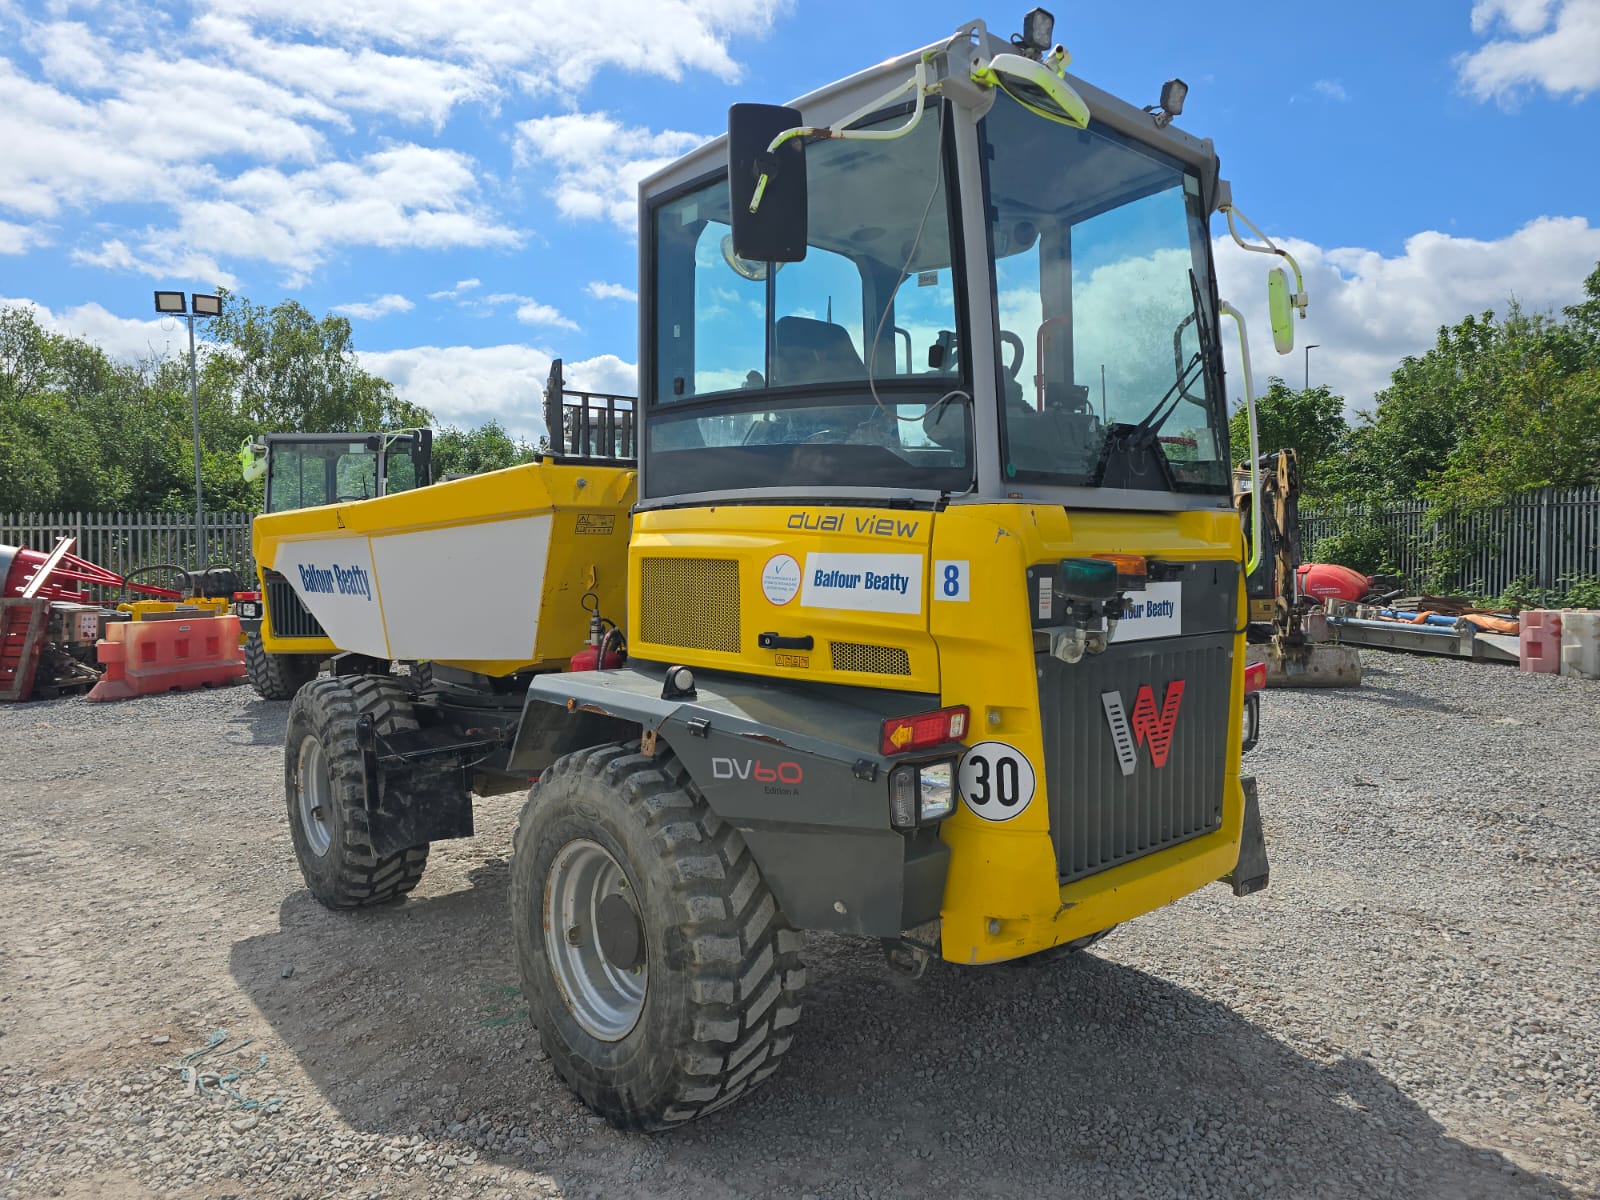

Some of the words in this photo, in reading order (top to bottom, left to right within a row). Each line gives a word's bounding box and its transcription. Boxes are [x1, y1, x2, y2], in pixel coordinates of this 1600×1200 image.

[787, 512, 845, 532] dual
[855, 515, 919, 538] view
[298, 564, 334, 593] Balfour
[333, 564, 371, 601] Beatty
[813, 569, 861, 589] Balfour
[864, 571, 909, 595] Beatty
[943, 564, 960, 597] 8
[1146, 600, 1174, 618] Beatty
[711, 757, 803, 784] DV60
[969, 755, 1019, 806] 30
[764, 786, 792, 796] Edition
[793, 788, 800, 796] A
